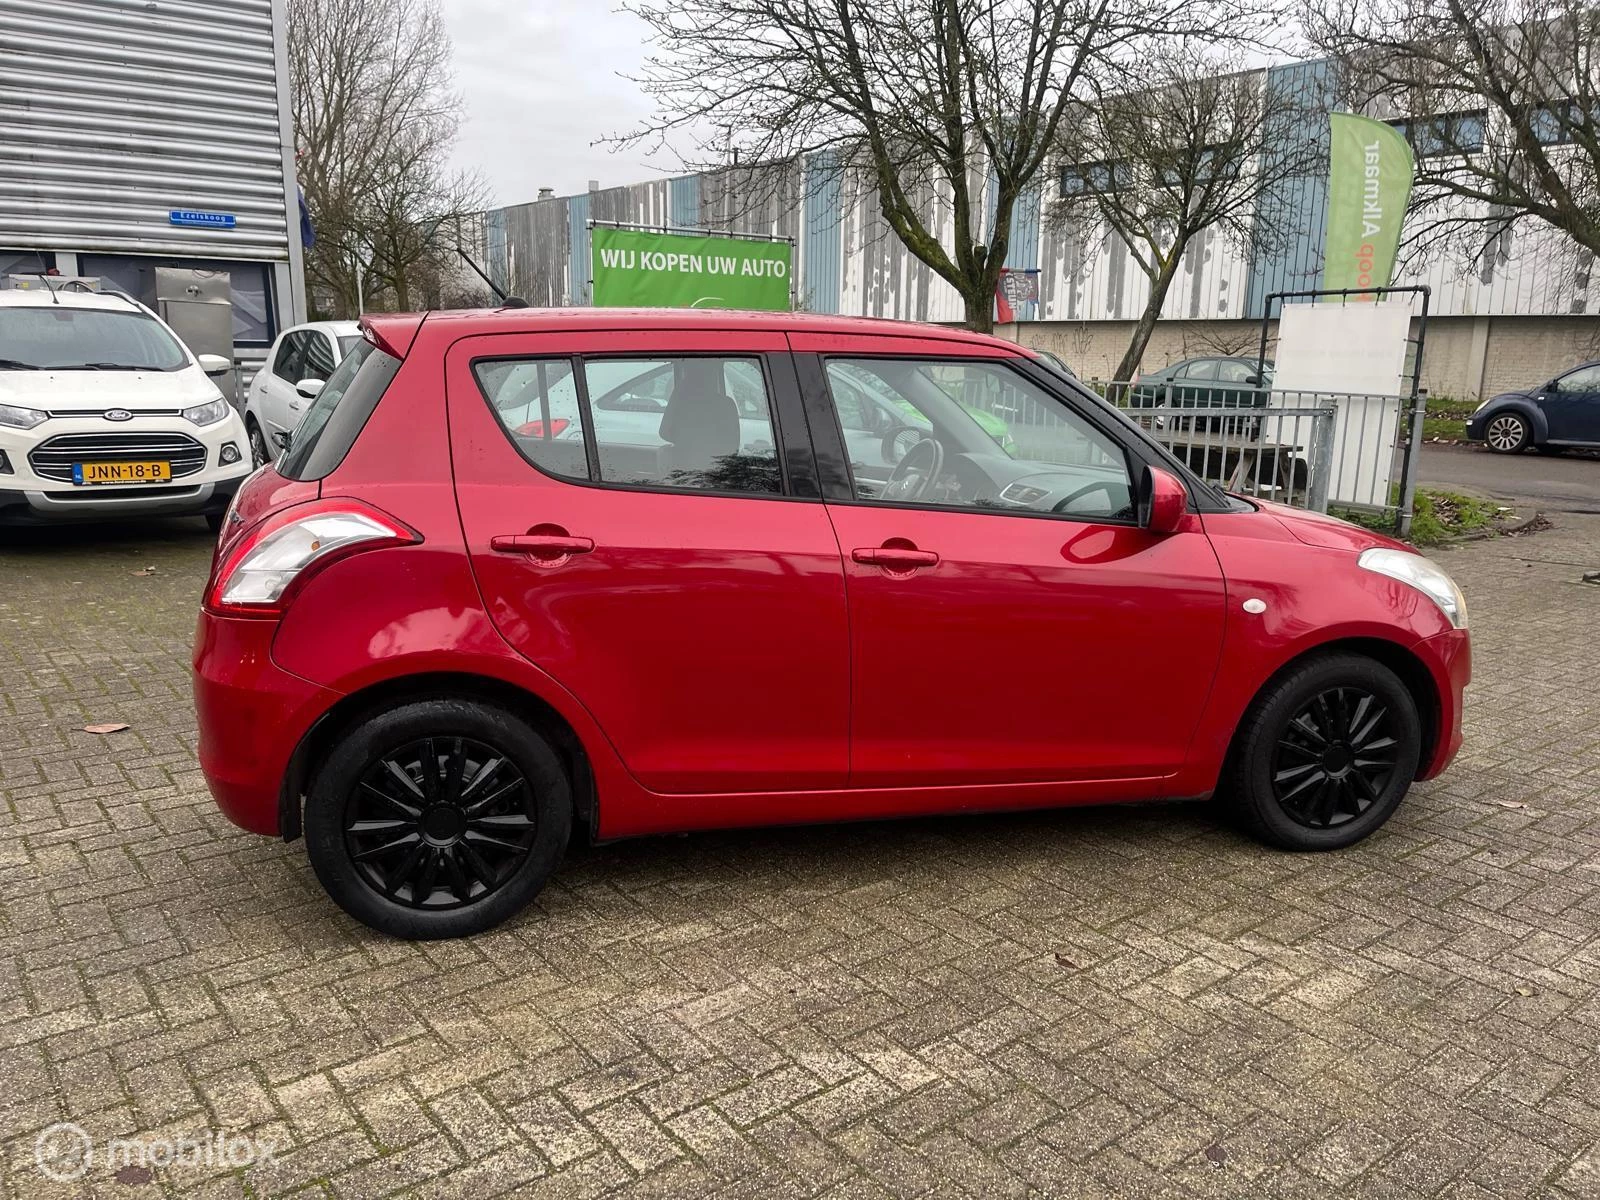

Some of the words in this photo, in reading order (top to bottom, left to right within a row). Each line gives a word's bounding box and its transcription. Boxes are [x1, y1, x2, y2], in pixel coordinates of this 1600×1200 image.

[600, 248, 636, 270] WIJ
[640, 251, 703, 274] KOPEN
[707, 256, 737, 276] UW
[741, 258, 786, 278] AUTO
[88, 464, 161, 479] JNN-18-B
